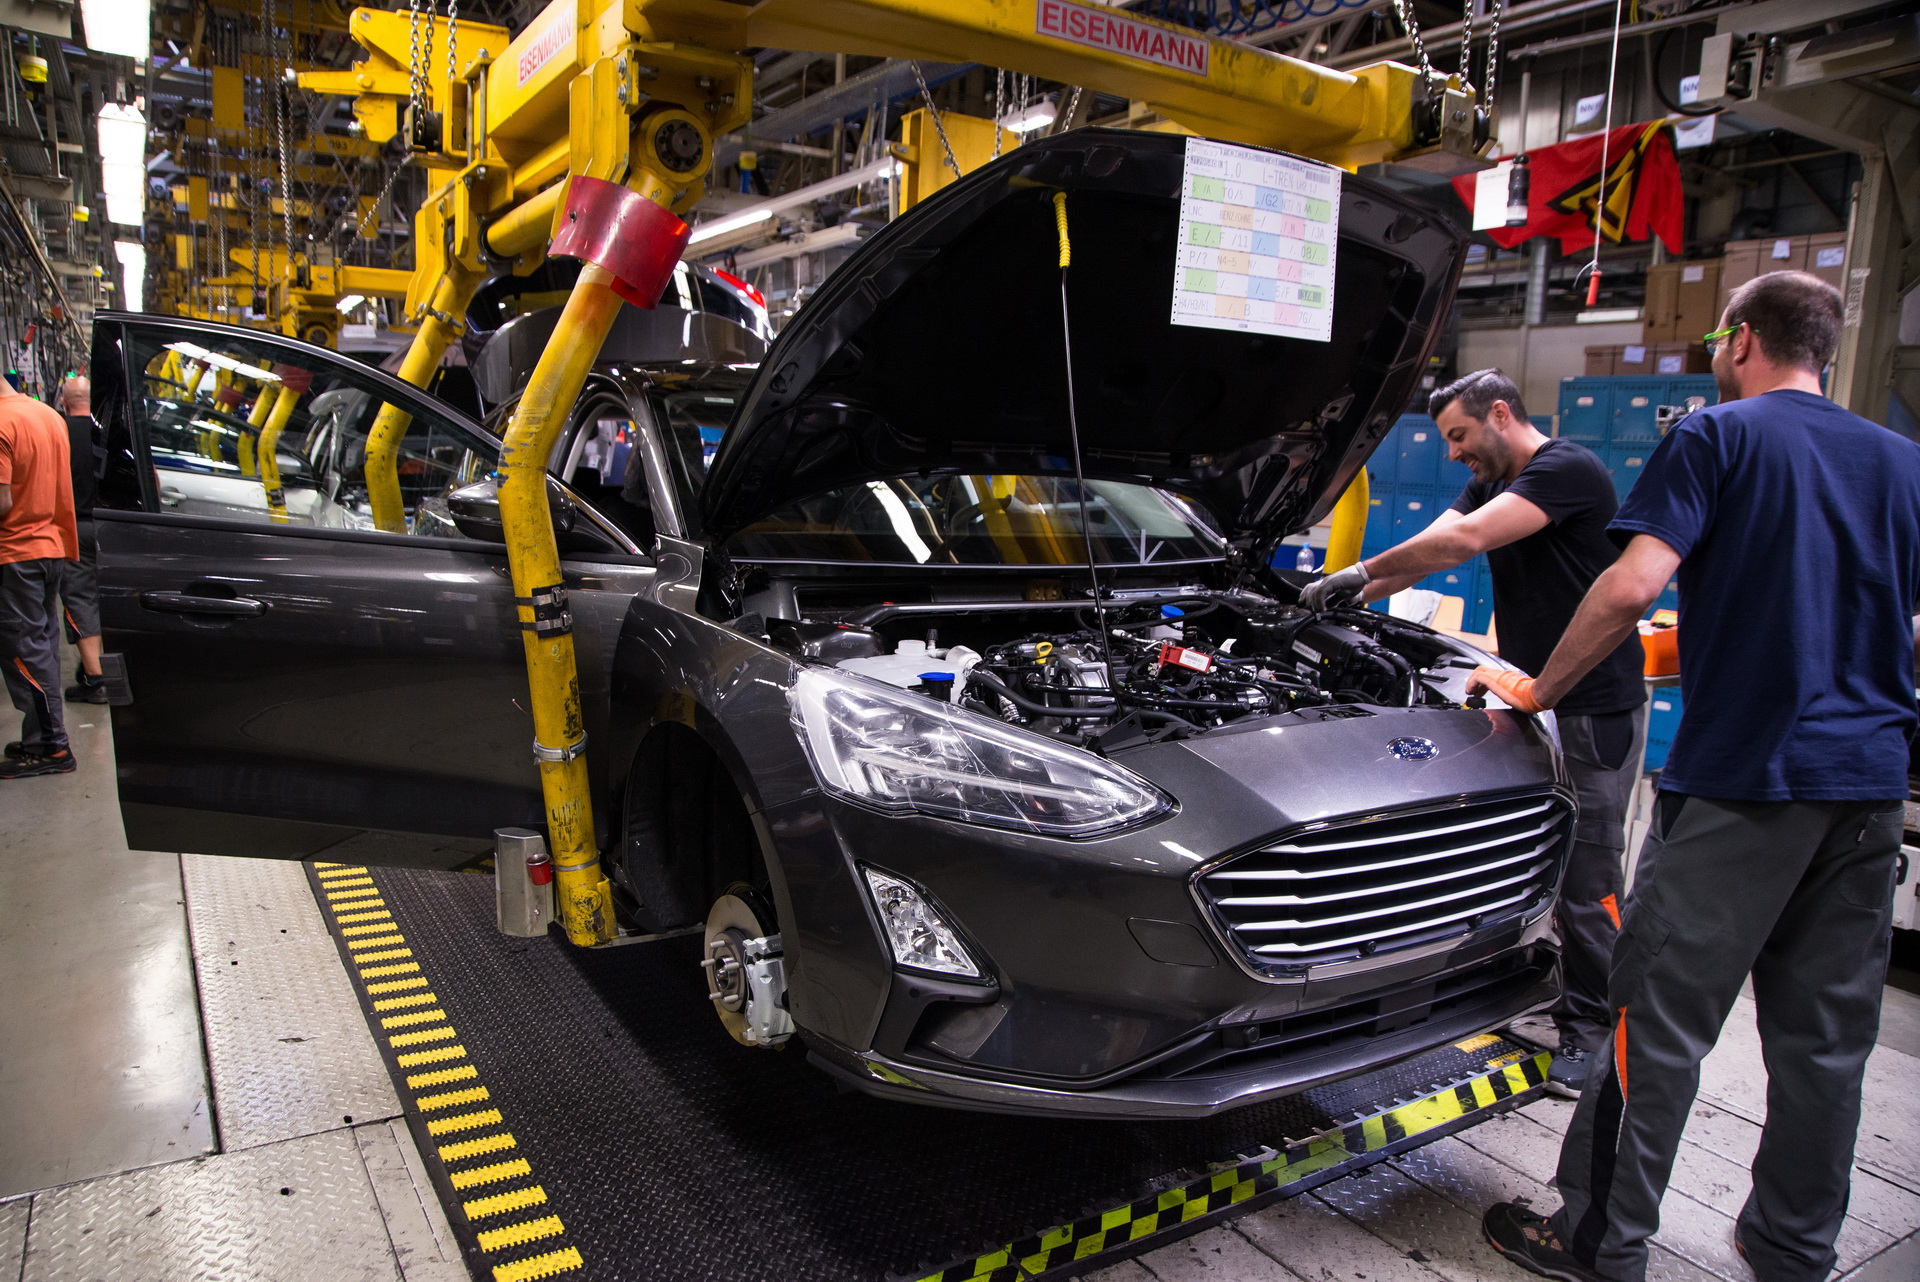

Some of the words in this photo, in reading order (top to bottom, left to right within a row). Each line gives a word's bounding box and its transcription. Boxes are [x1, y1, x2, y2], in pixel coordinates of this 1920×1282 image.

[519, 11, 572, 82] EISENMANN
[1042, 1, 1204, 70] EISENMANN
[1222, 148, 1257, 161] FOCUS
[1262, 167, 1294, 189] L-TREN
